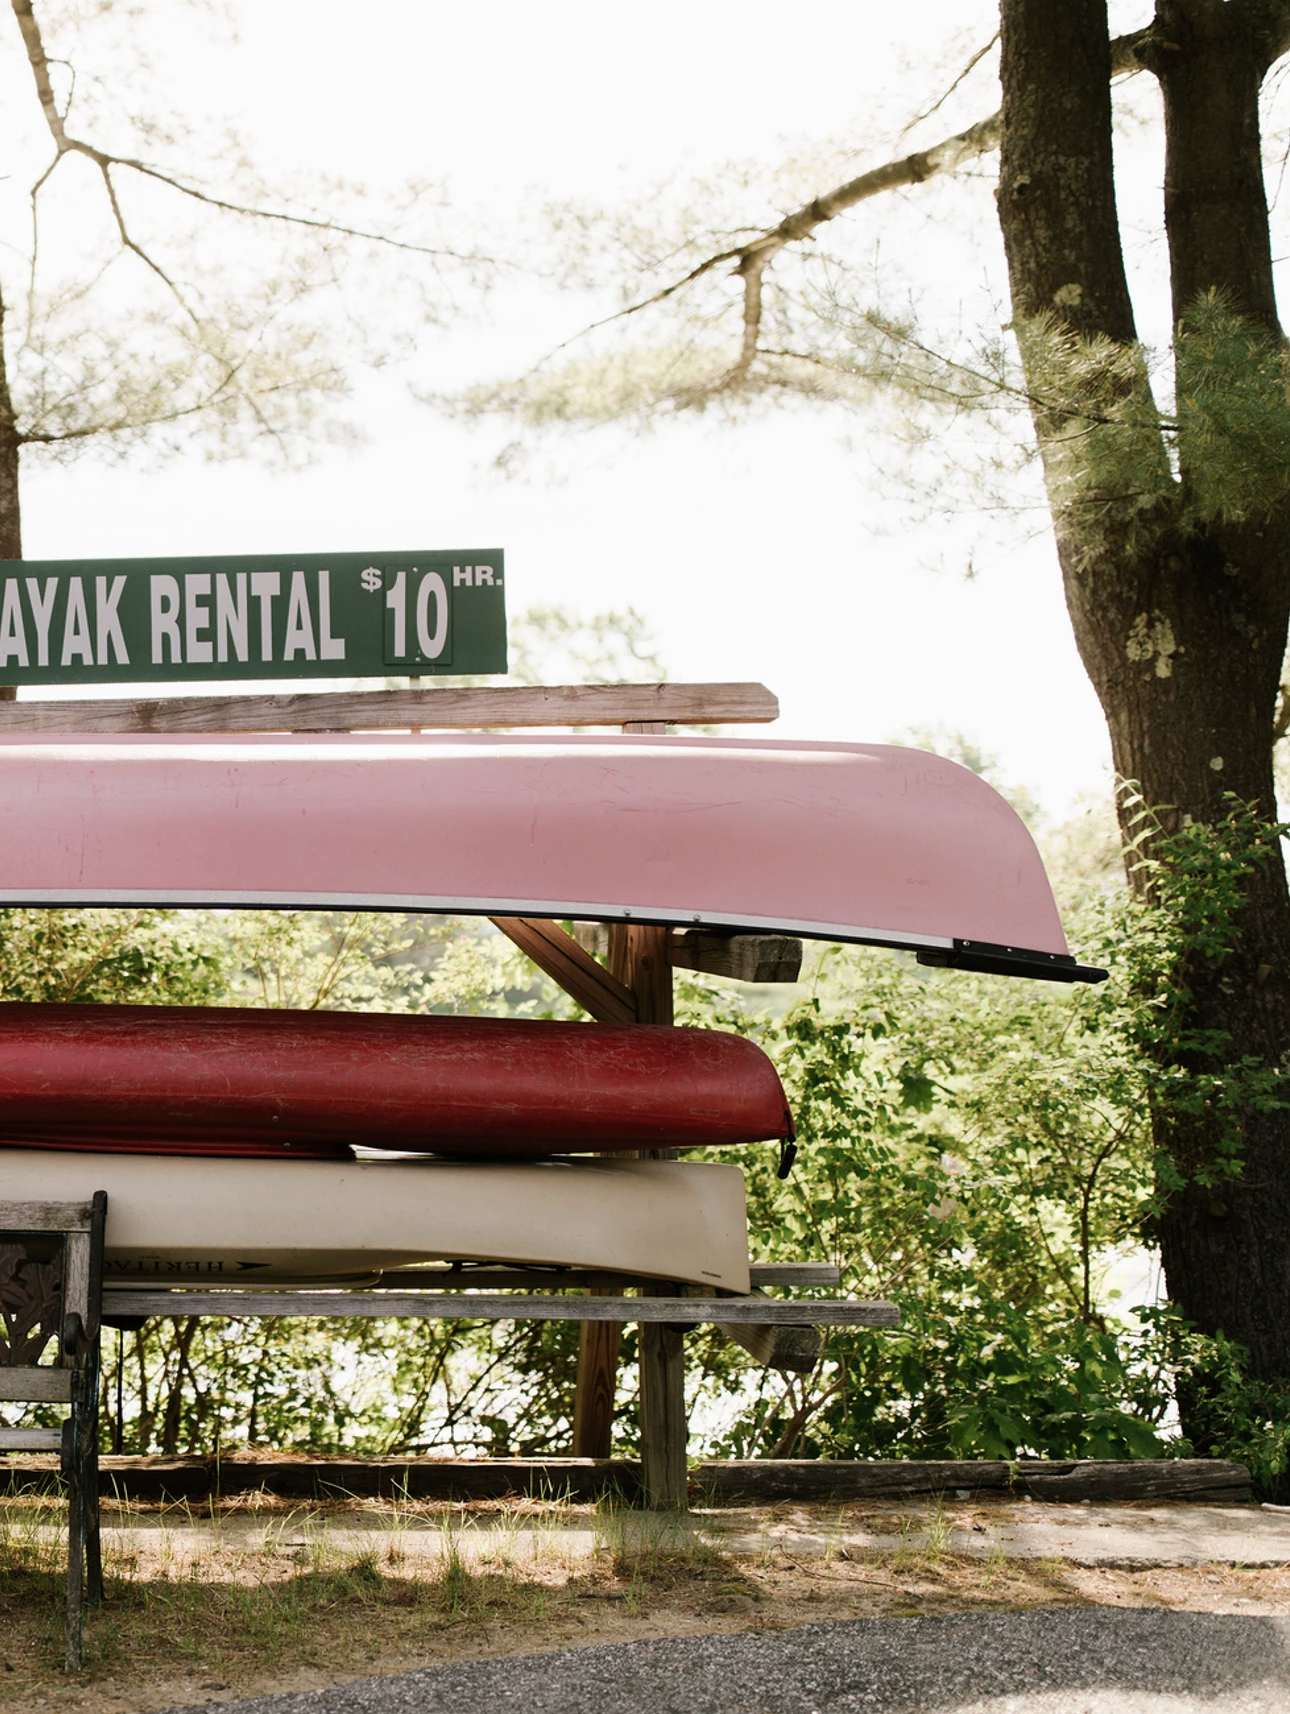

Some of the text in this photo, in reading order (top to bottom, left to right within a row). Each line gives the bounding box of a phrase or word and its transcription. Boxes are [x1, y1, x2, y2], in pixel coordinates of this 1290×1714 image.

[150, 570, 346, 664] RENTAL
[360, 566, 448, 659] $10
[452, 565, 503, 587] HR.
